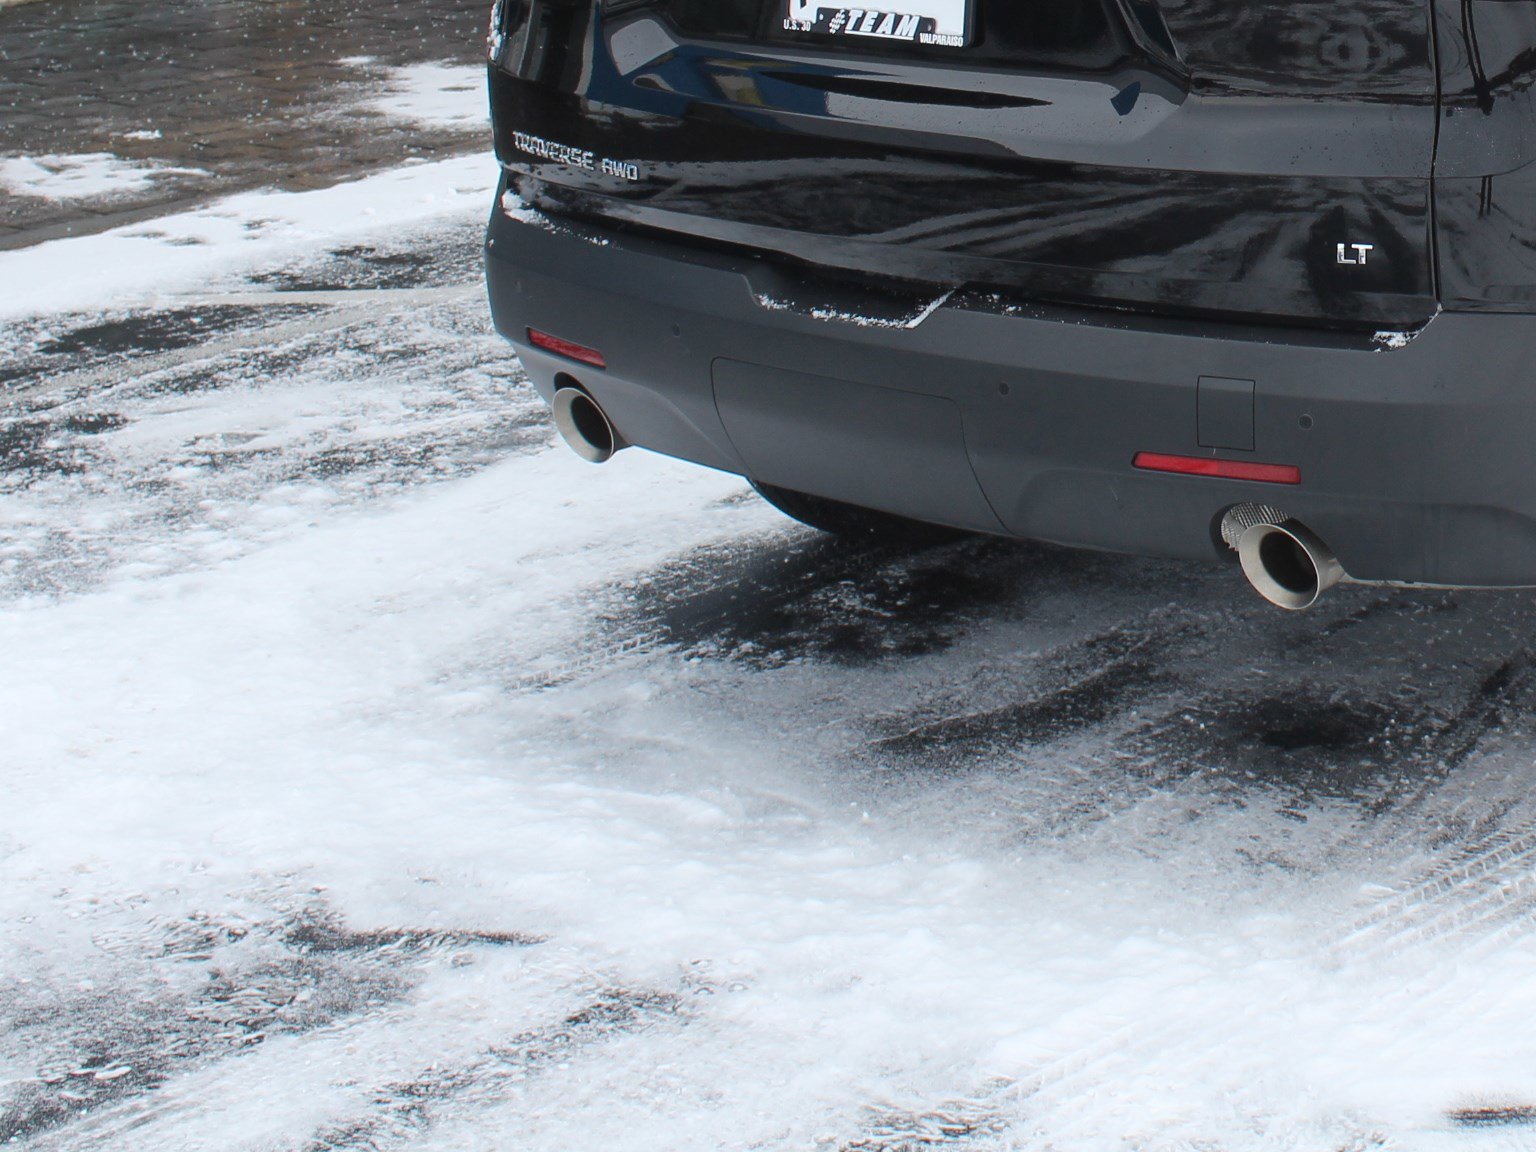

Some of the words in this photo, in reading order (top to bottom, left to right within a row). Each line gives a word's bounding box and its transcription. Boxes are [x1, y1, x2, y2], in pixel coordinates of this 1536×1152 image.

[783, 18, 799, 30] U.S.
[801, 20, 811, 32] 30
[845, 9, 921, 37] TEAM
[919, 32, 964, 47] VALPARAISO
[512, 130, 595, 171] TRAVERSE
[601, 158, 638, 181] AWD
[1336, 243, 1374, 265] LT
